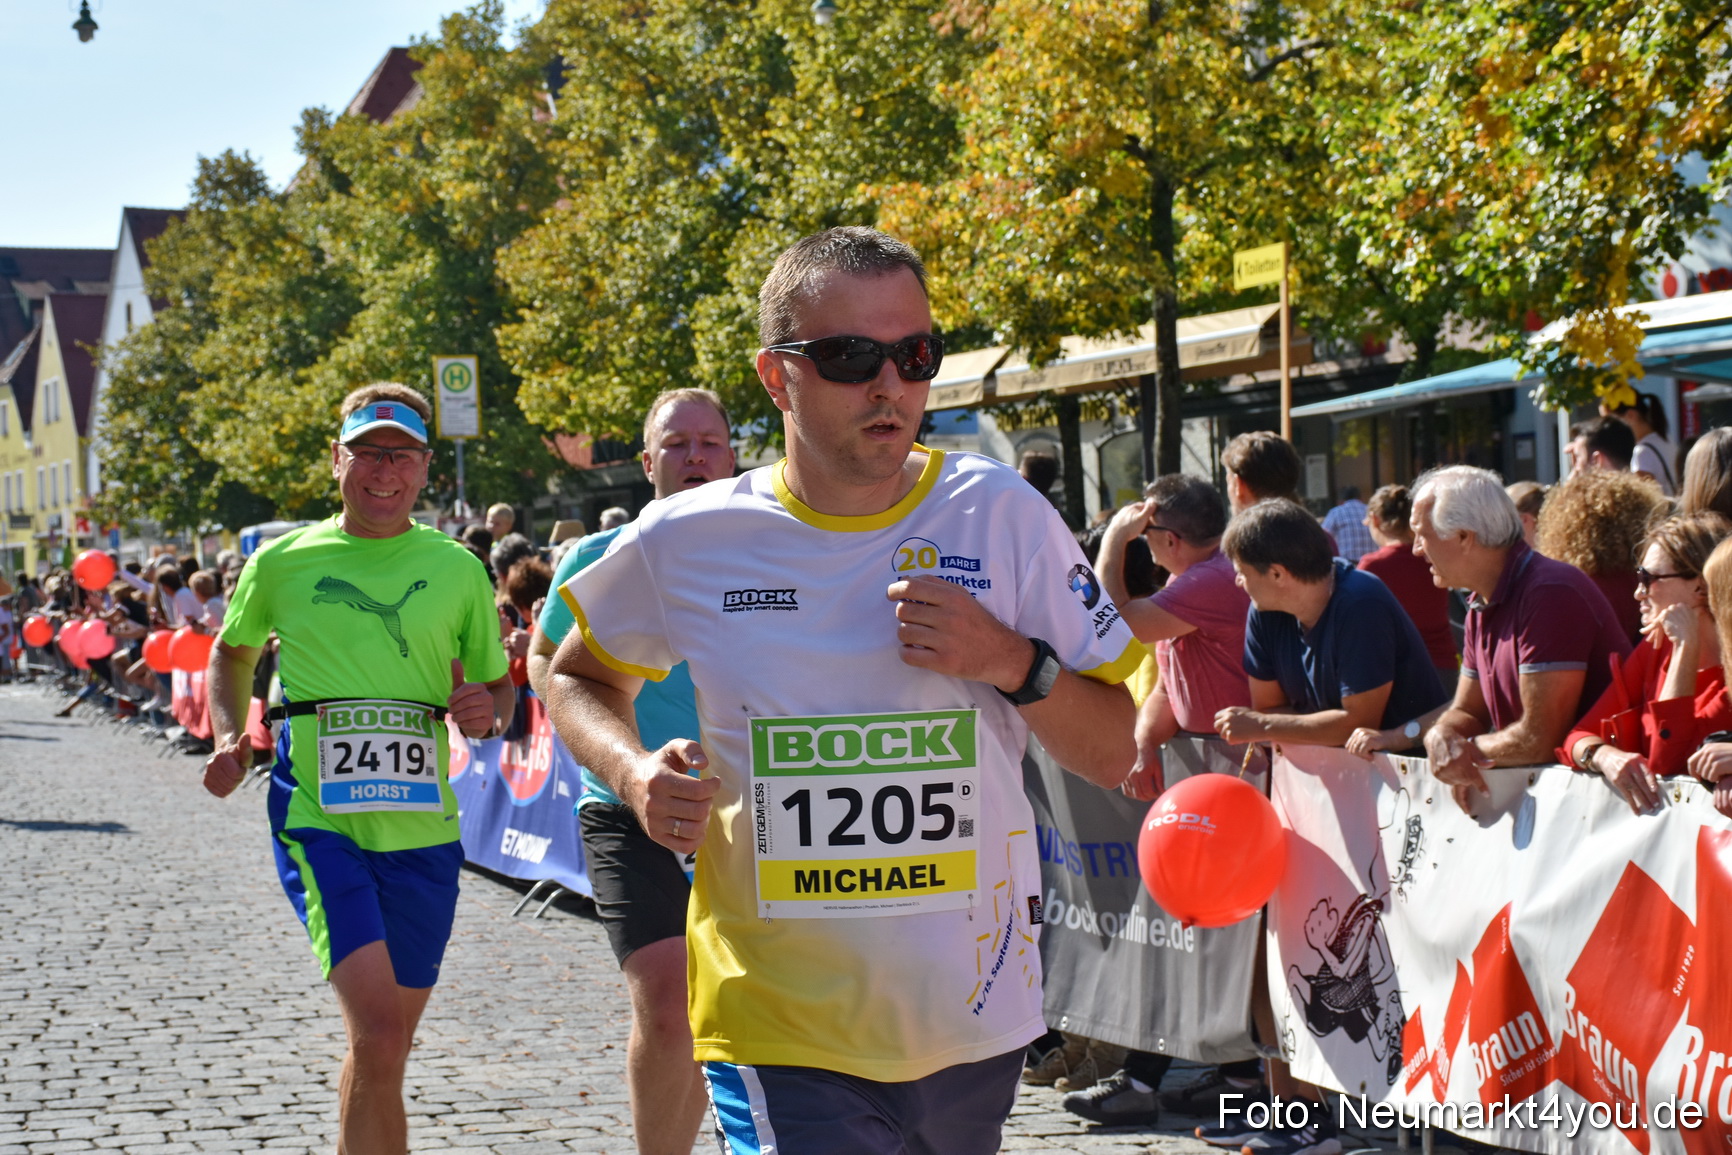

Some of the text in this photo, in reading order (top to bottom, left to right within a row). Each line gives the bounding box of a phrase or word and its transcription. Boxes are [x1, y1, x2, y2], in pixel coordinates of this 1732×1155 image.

[1244, 258, 1281, 276] Toiletten
[450, 370, 464, 385] H
[898, 547, 937, 572] 20
[944, 558, 977, 570] JAHRE
[723, 588, 799, 608] BOCK
[327, 705, 427, 735] BOCK
[333, 740, 426, 776] 2419
[767, 717, 962, 769] BOCK
[350, 784, 411, 800] HORST
[962, 785, 971, 796] D
[781, 782, 956, 847] 1205
[794, 863, 946, 894] MICHAEL
[1043, 888, 1195, 953] bockonline.de
[1672, 944, 1695, 997] Seit 1929
[1470, 1010, 1544, 1091] Braun
[1563, 983, 1640, 1109] Braun
[1500, 1068, 1525, 1087] Sicher
